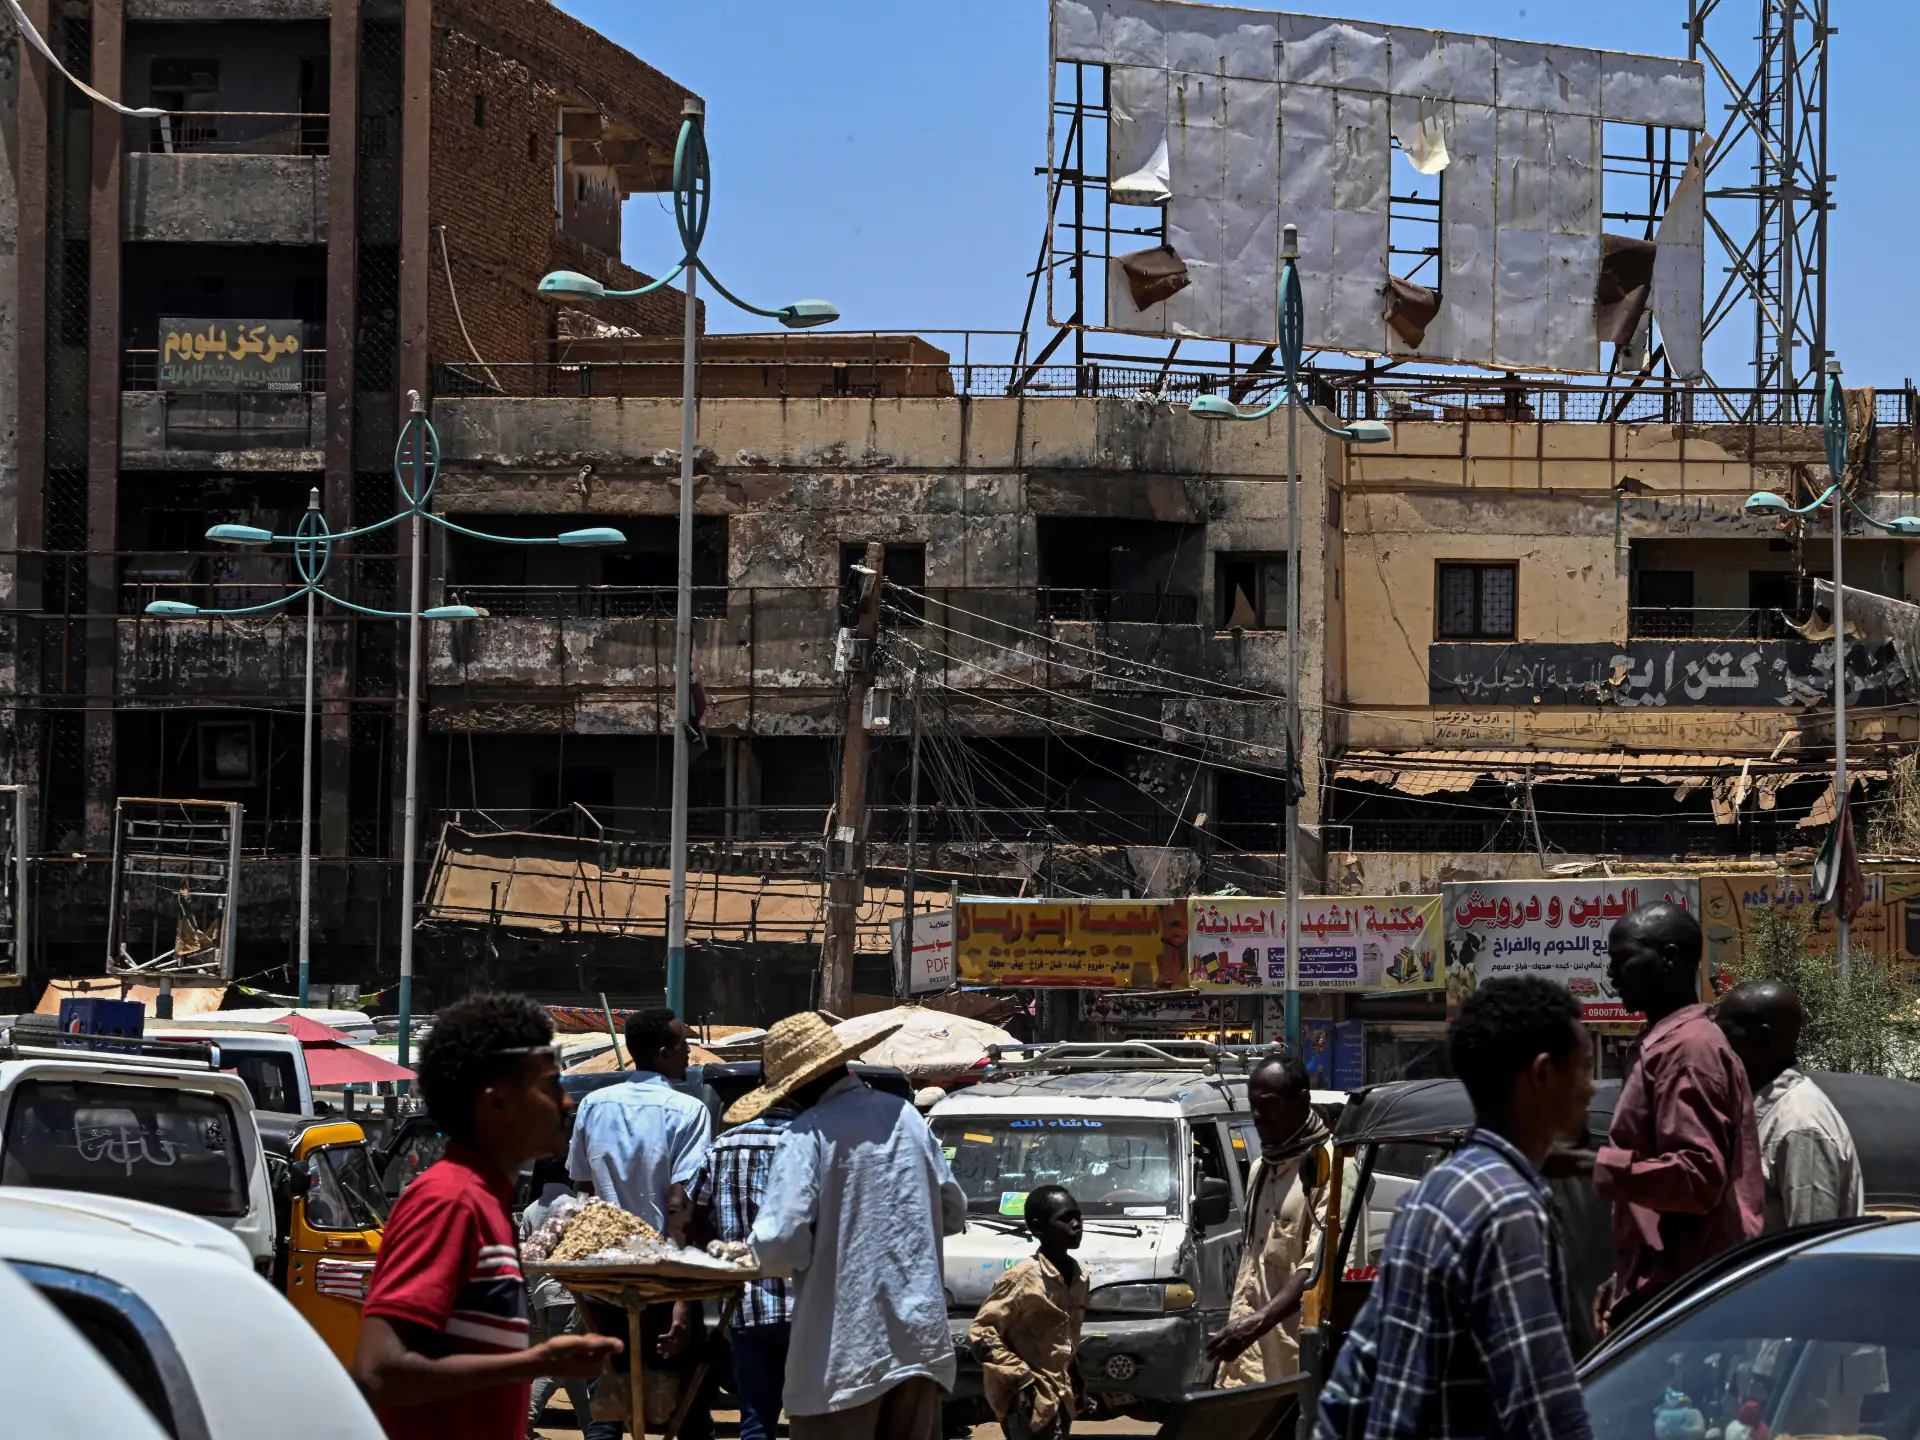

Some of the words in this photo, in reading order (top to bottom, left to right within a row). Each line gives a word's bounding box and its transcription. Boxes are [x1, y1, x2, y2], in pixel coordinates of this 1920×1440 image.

[164, 324, 227, 363] بلووم
[228, 325, 299, 363] مركز
[1455, 888, 1542, 929] درويش
[1547, 895, 1564, 928] و
[1193, 904, 1276, 944] الحديثة
[1280, 904, 1360, 940] الشهدء
[1362, 904, 1424, 941] مكتبة
[1303, 948, 1334, 961] مكتبية
[1493, 936, 1541, 958] والفراخ
[1543, 936, 1590, 957] اللحوم
[926, 956, 951, 973] PDF
[1315, 964, 1355, 975] خدمات
[1492, 963, 1511, 972] مفروم
[1515, 962, 1528, 972] فراخ
[1010, 1118, 1044, 1128] الله
